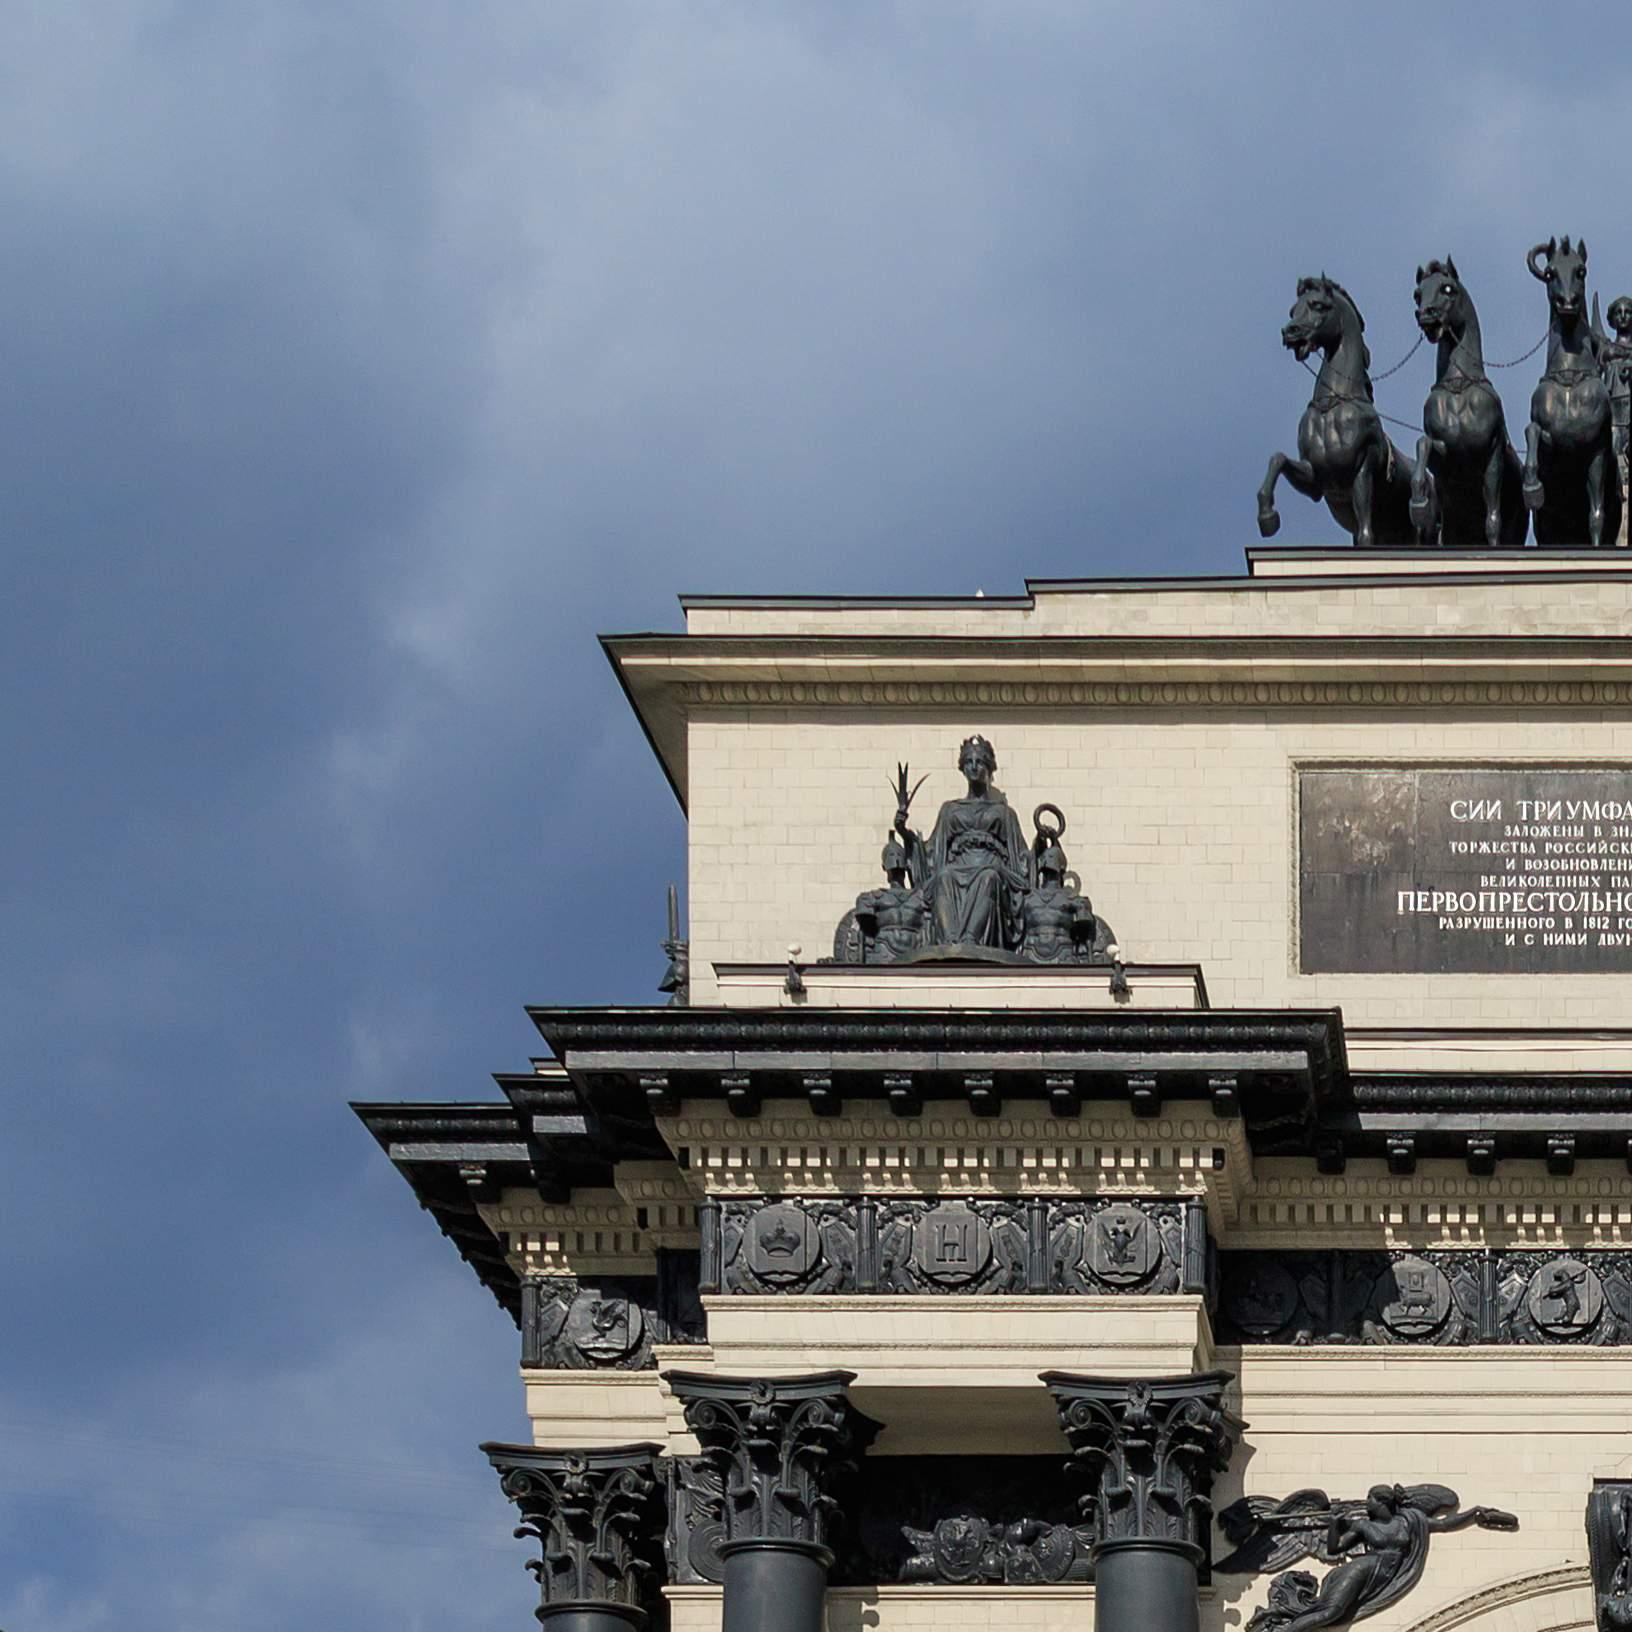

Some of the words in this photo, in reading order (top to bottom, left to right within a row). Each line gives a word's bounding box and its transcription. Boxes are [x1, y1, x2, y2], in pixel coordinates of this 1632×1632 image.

[1450, 799, 1502, 820] СИИ
[1504, 824, 1584, 837] ЗАЛОЖЕНЫ
[1594, 824, 1602, 837] В
[1448, 841, 1536, 854] ТОРЖЕСТВА
[1505, 857, 1516, 870] И
[1480, 874, 1601, 887] ВЕЛИКОЛЕПНЫХ
[1439, 916, 1556, 929] РАЗРУШЕННОГО
[1564, 916, 1573, 929] В
[1583, 916, 1610, 929] 1812
[1504, 933, 1516, 946] И
[1524, 933, 1535, 946] С
[1543, 933, 1588, 946] НИМИ
